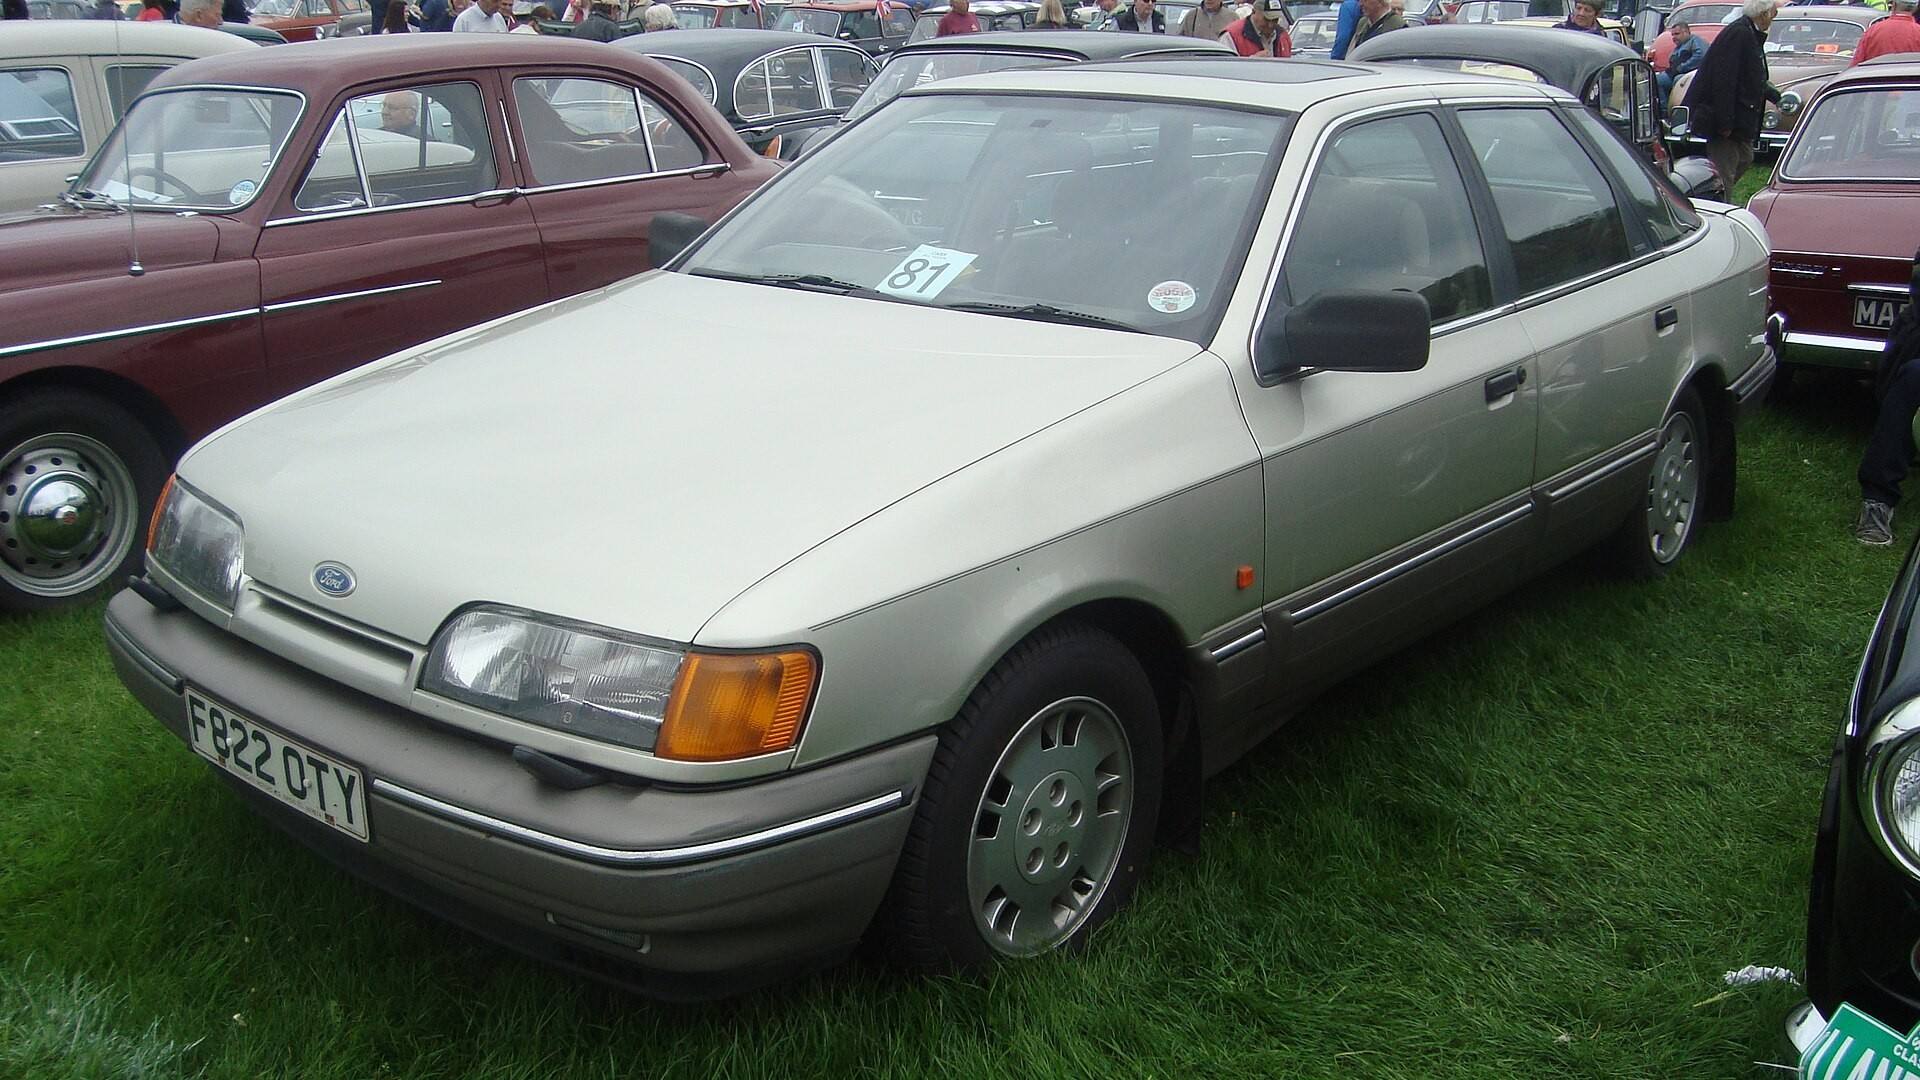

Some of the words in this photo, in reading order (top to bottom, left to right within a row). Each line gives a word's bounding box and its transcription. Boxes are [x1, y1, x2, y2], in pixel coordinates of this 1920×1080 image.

[887, 258, 951, 294] 81
[320, 569, 345, 589] Ford
[188, 694, 276, 786] F822
[282, 745, 356, 825] OTY
